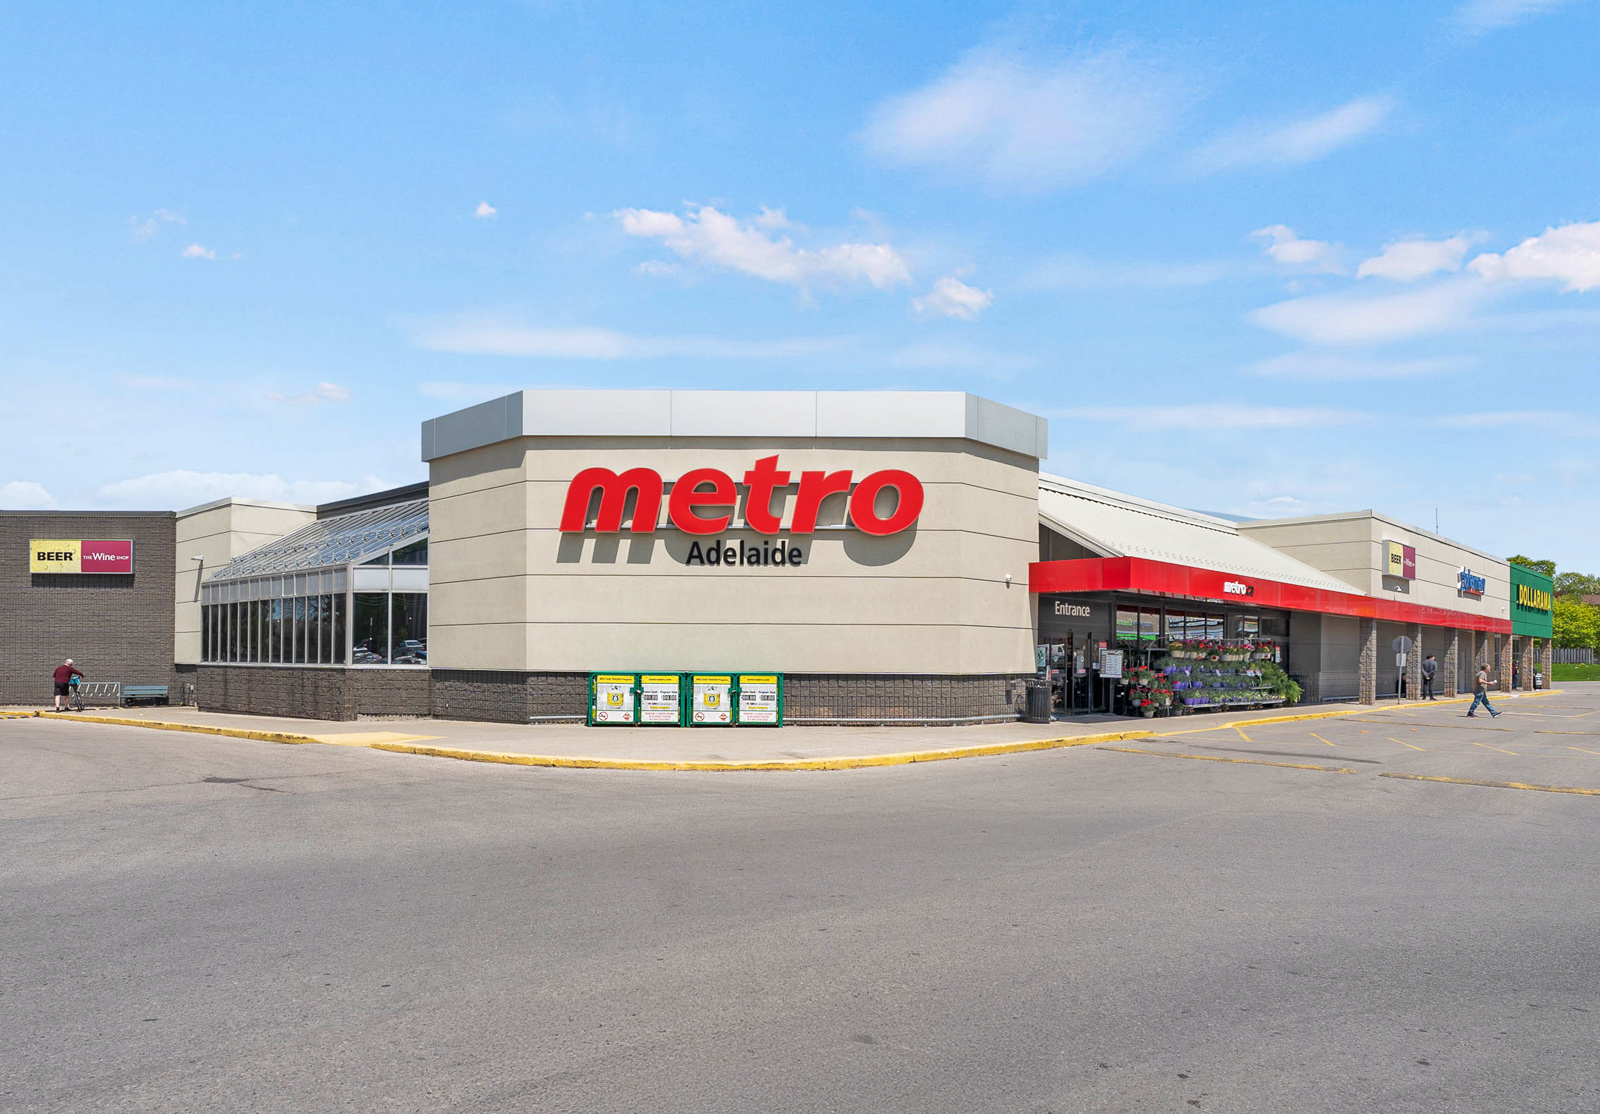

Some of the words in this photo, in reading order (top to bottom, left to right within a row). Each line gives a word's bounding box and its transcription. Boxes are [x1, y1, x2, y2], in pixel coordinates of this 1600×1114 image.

[559, 453, 925, 537] metro
[37, 552, 73, 561] BEER
[92, 553, 116, 561] Wine
[686, 540, 803, 566] Adelaide
[1391, 553, 1402, 565] BEER
[1519, 583, 1551, 611] DOLLARAMA
[1055, 600, 1091, 617] Entrance
